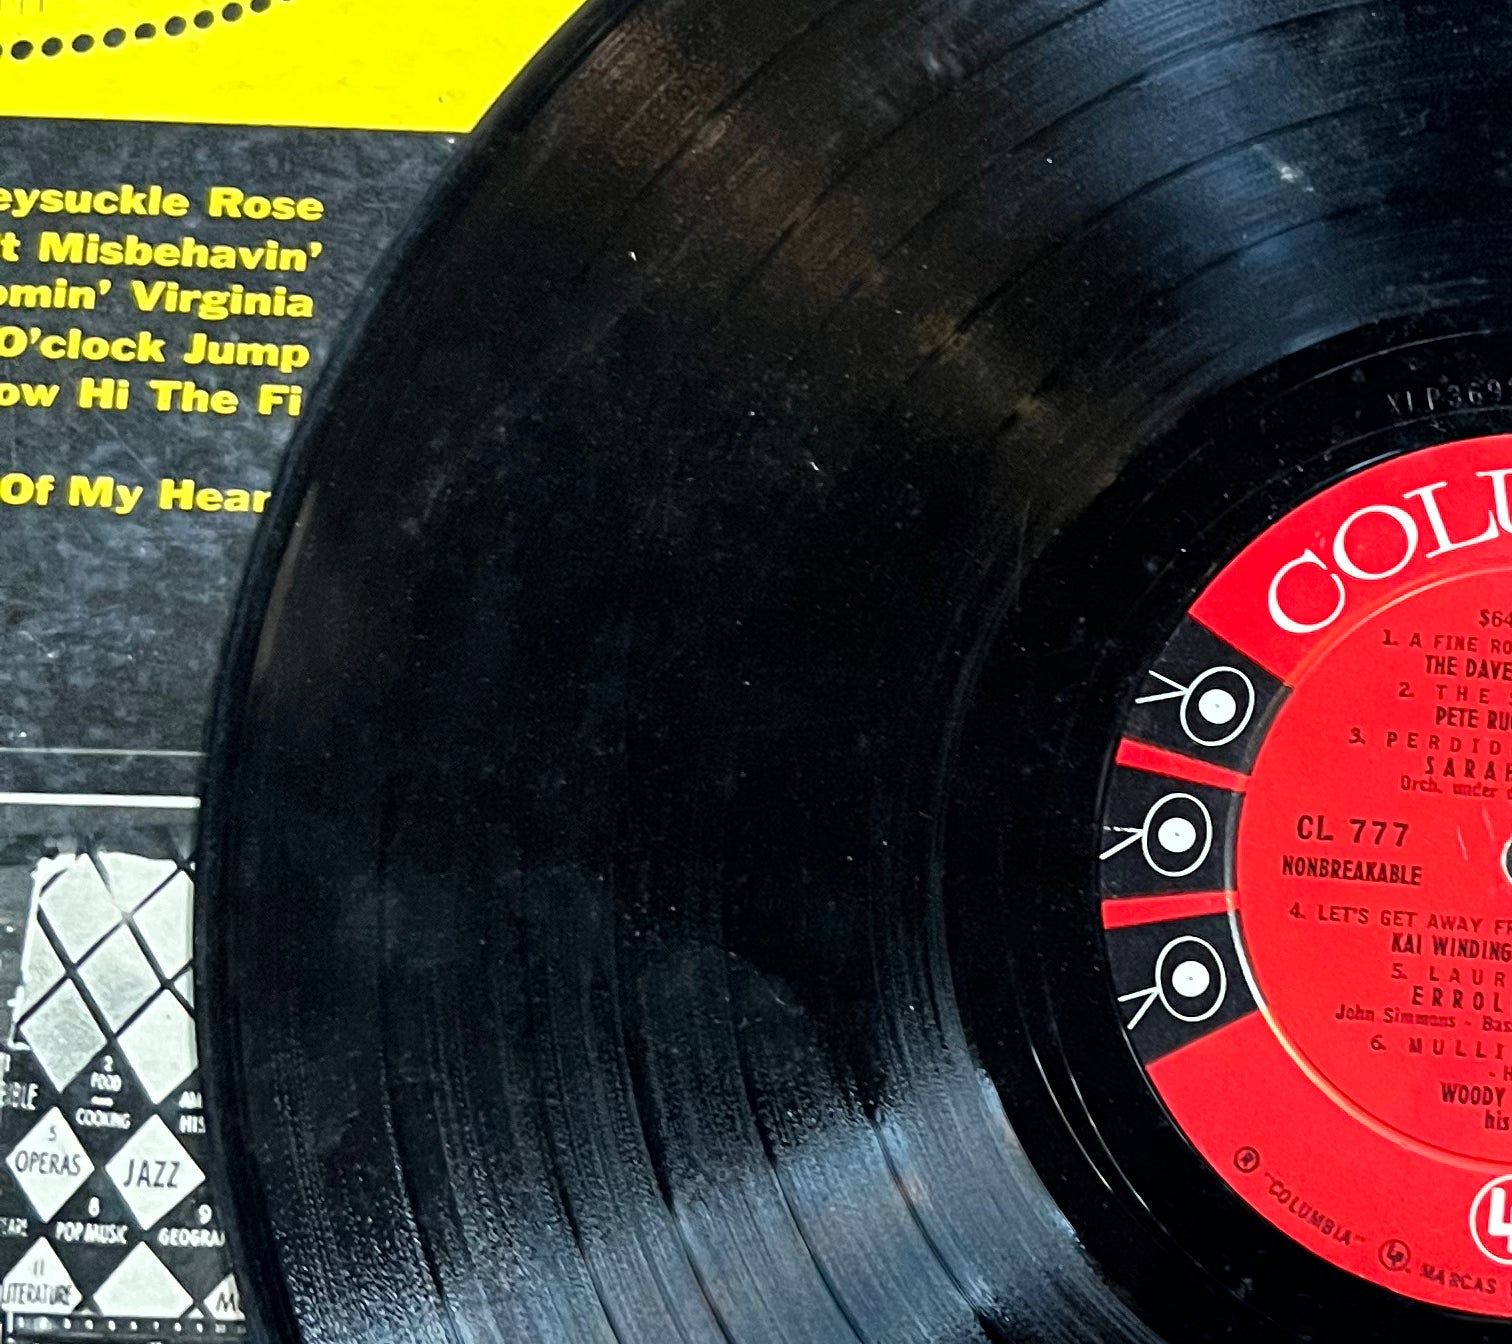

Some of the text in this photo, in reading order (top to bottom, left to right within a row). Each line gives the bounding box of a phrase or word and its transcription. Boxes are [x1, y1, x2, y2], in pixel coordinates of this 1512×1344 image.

[208, 186, 324, 221] Rose
[38, 231, 323, 272] Misbehavin'
[0, 278, 313, 320] min' Virginia
[0, 325, 310, 373] O'clock Jump
[78, 377, 130, 410] Hi
[149, 379, 239, 414] The
[258, 384, 303, 416] Fi
[0, 472, 56, 506] Of
[68, 475, 144, 514] My
[1409, 632, 1422, 649] A
[1433, 634, 1479, 652] FINE
[1425, 655, 1458, 676] THE
[1465, 658, 1512, 681] DAVE
[1435, 684, 1491, 705] THE
[1435, 706, 1480, 729] PETE
[1452, 781, 1499, 798] under
[1297, 814, 1409, 848] CL 777
[1282, 854, 1423, 886] NONBREAKABLE
[1318, 904, 1369, 925] LET'S
[1380, 909, 1419, 928] GET
[1427, 913, 1484, 933] AWAY
[1391, 932, 1422, 955] KAI
[1431, 935, 1512, 963] WINDING
[1335, 1003, 1375, 1021] John
[1383, 1007, 1456, 1028] Simmons
[1440, 1080, 1507, 1107] WOODY
[1484, 1109, 1510, 1131] his
[15, 1150, 82, 1177] OPERAS
[123, 1159, 181, 1189] JAZZ
[1420, 1263, 1497, 1295] MARCAS
